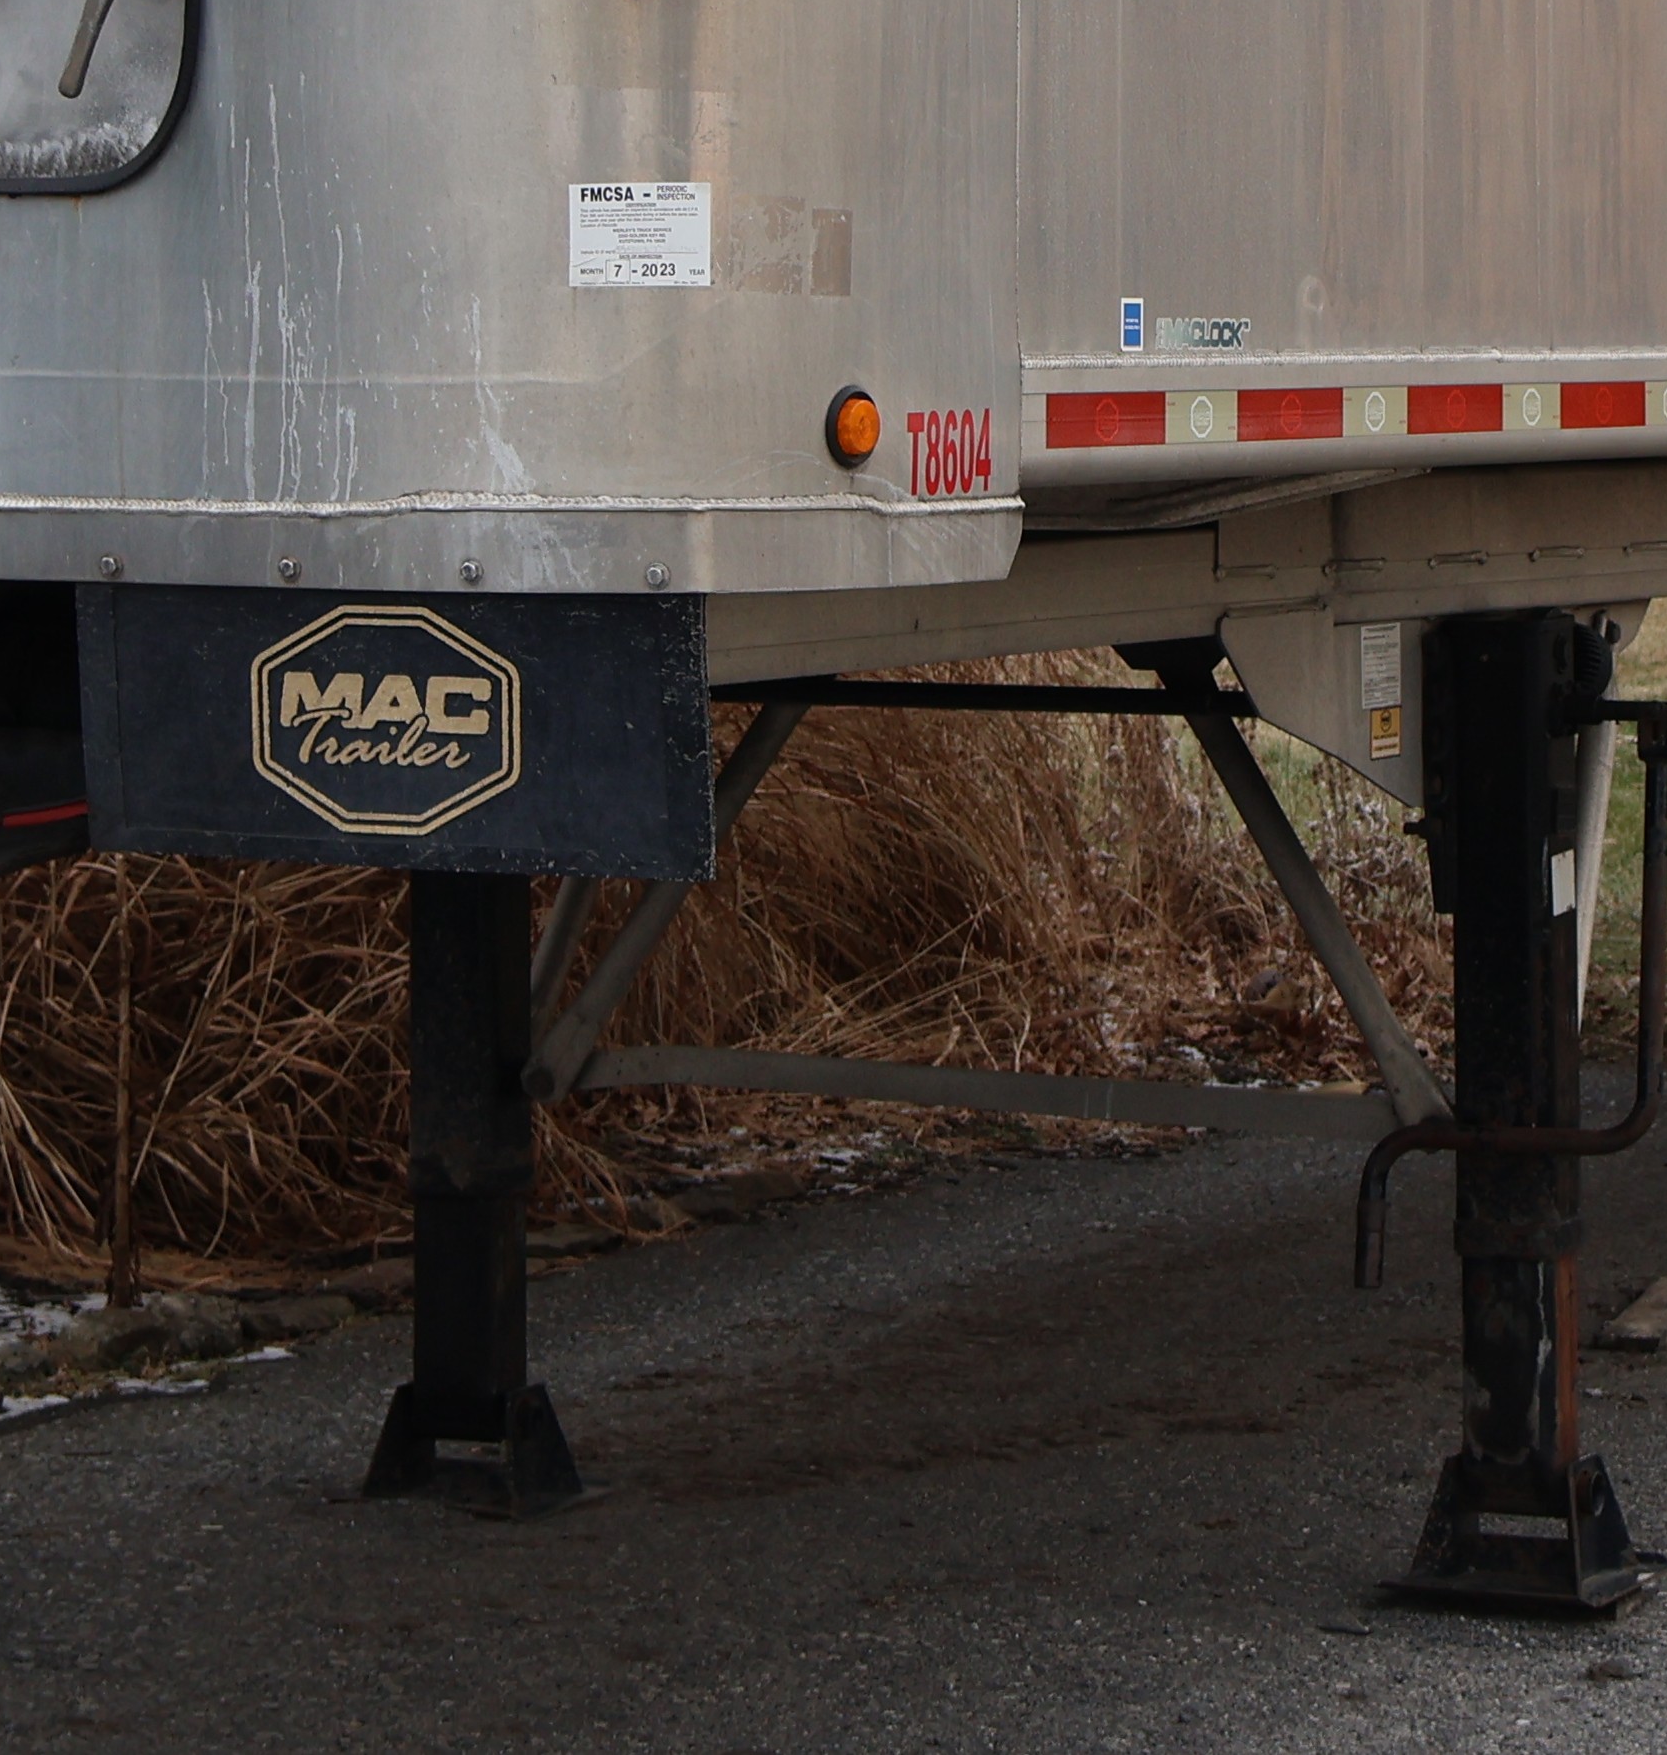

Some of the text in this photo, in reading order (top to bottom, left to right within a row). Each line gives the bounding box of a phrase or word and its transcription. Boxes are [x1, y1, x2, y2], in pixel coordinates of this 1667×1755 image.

[580, 186, 634, 203] FMCSA
[656, 185, 688, 193] PERIODIC
[656, 192, 696, 201] INSPECTION
[580, 267, 604, 275] MONTH
[614, 264, 622, 278] 7
[688, 268, 705, 276] YEAR
[906, 407, 991, 497] T8604
[279, 671, 493, 736] MAC
[293, 708, 471, 769] Trailer
